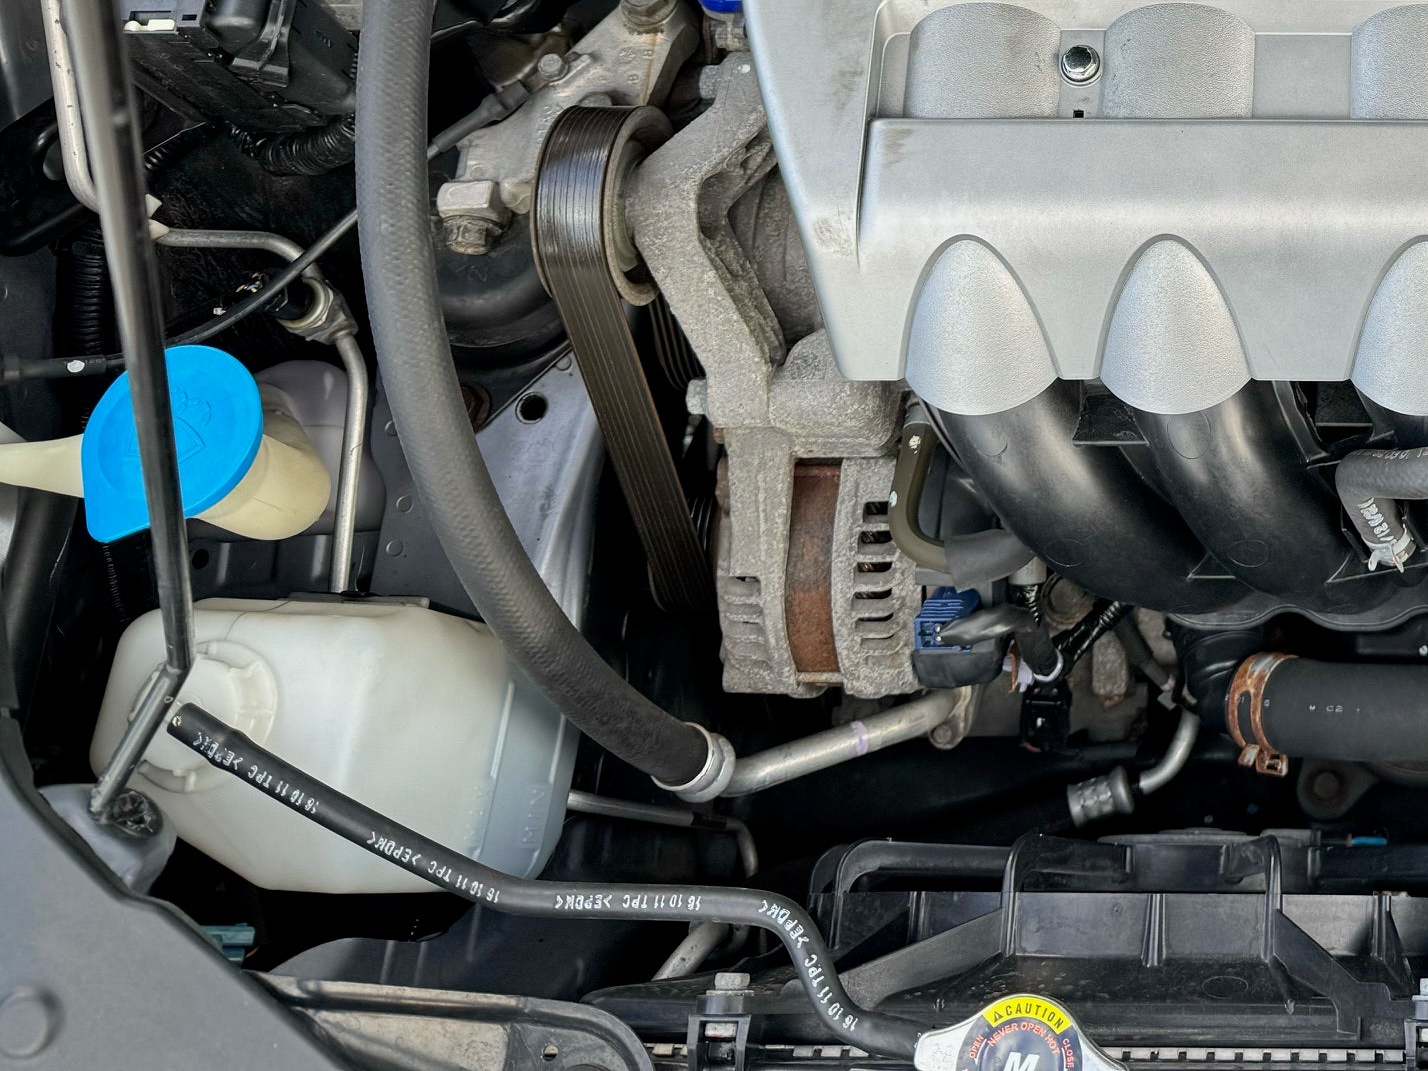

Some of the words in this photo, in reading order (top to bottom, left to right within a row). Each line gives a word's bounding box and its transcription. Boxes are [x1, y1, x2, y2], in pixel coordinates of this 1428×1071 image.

[246, 763, 273, 790] TPC
[426, 859, 452, 882] TPC
[454, 873, 469, 891] 11
[468, 880, 483, 898] 10
[484, 886, 501, 905] 16
[621, 894, 648, 909] TPC
[653, 894, 666, 910] 11
[668, 894, 683, 910] 10
[686, 895, 702, 912] 16
[803, 953, 827, 988] TPC
[815, 984, 833, 1004] 11
[827, 1002, 844, 1021] 10
[1004, 1002, 1065, 1031] CAUTION
[968, 1034, 985, 1060] OPEN
[986, 1022, 1019, 1048] NEVER
[1020, 1021, 1048, 1039] OPEN
[1044, 1031, 1062, 1056] HOT
[1062, 1038, 1075, 1069] CLOSE
